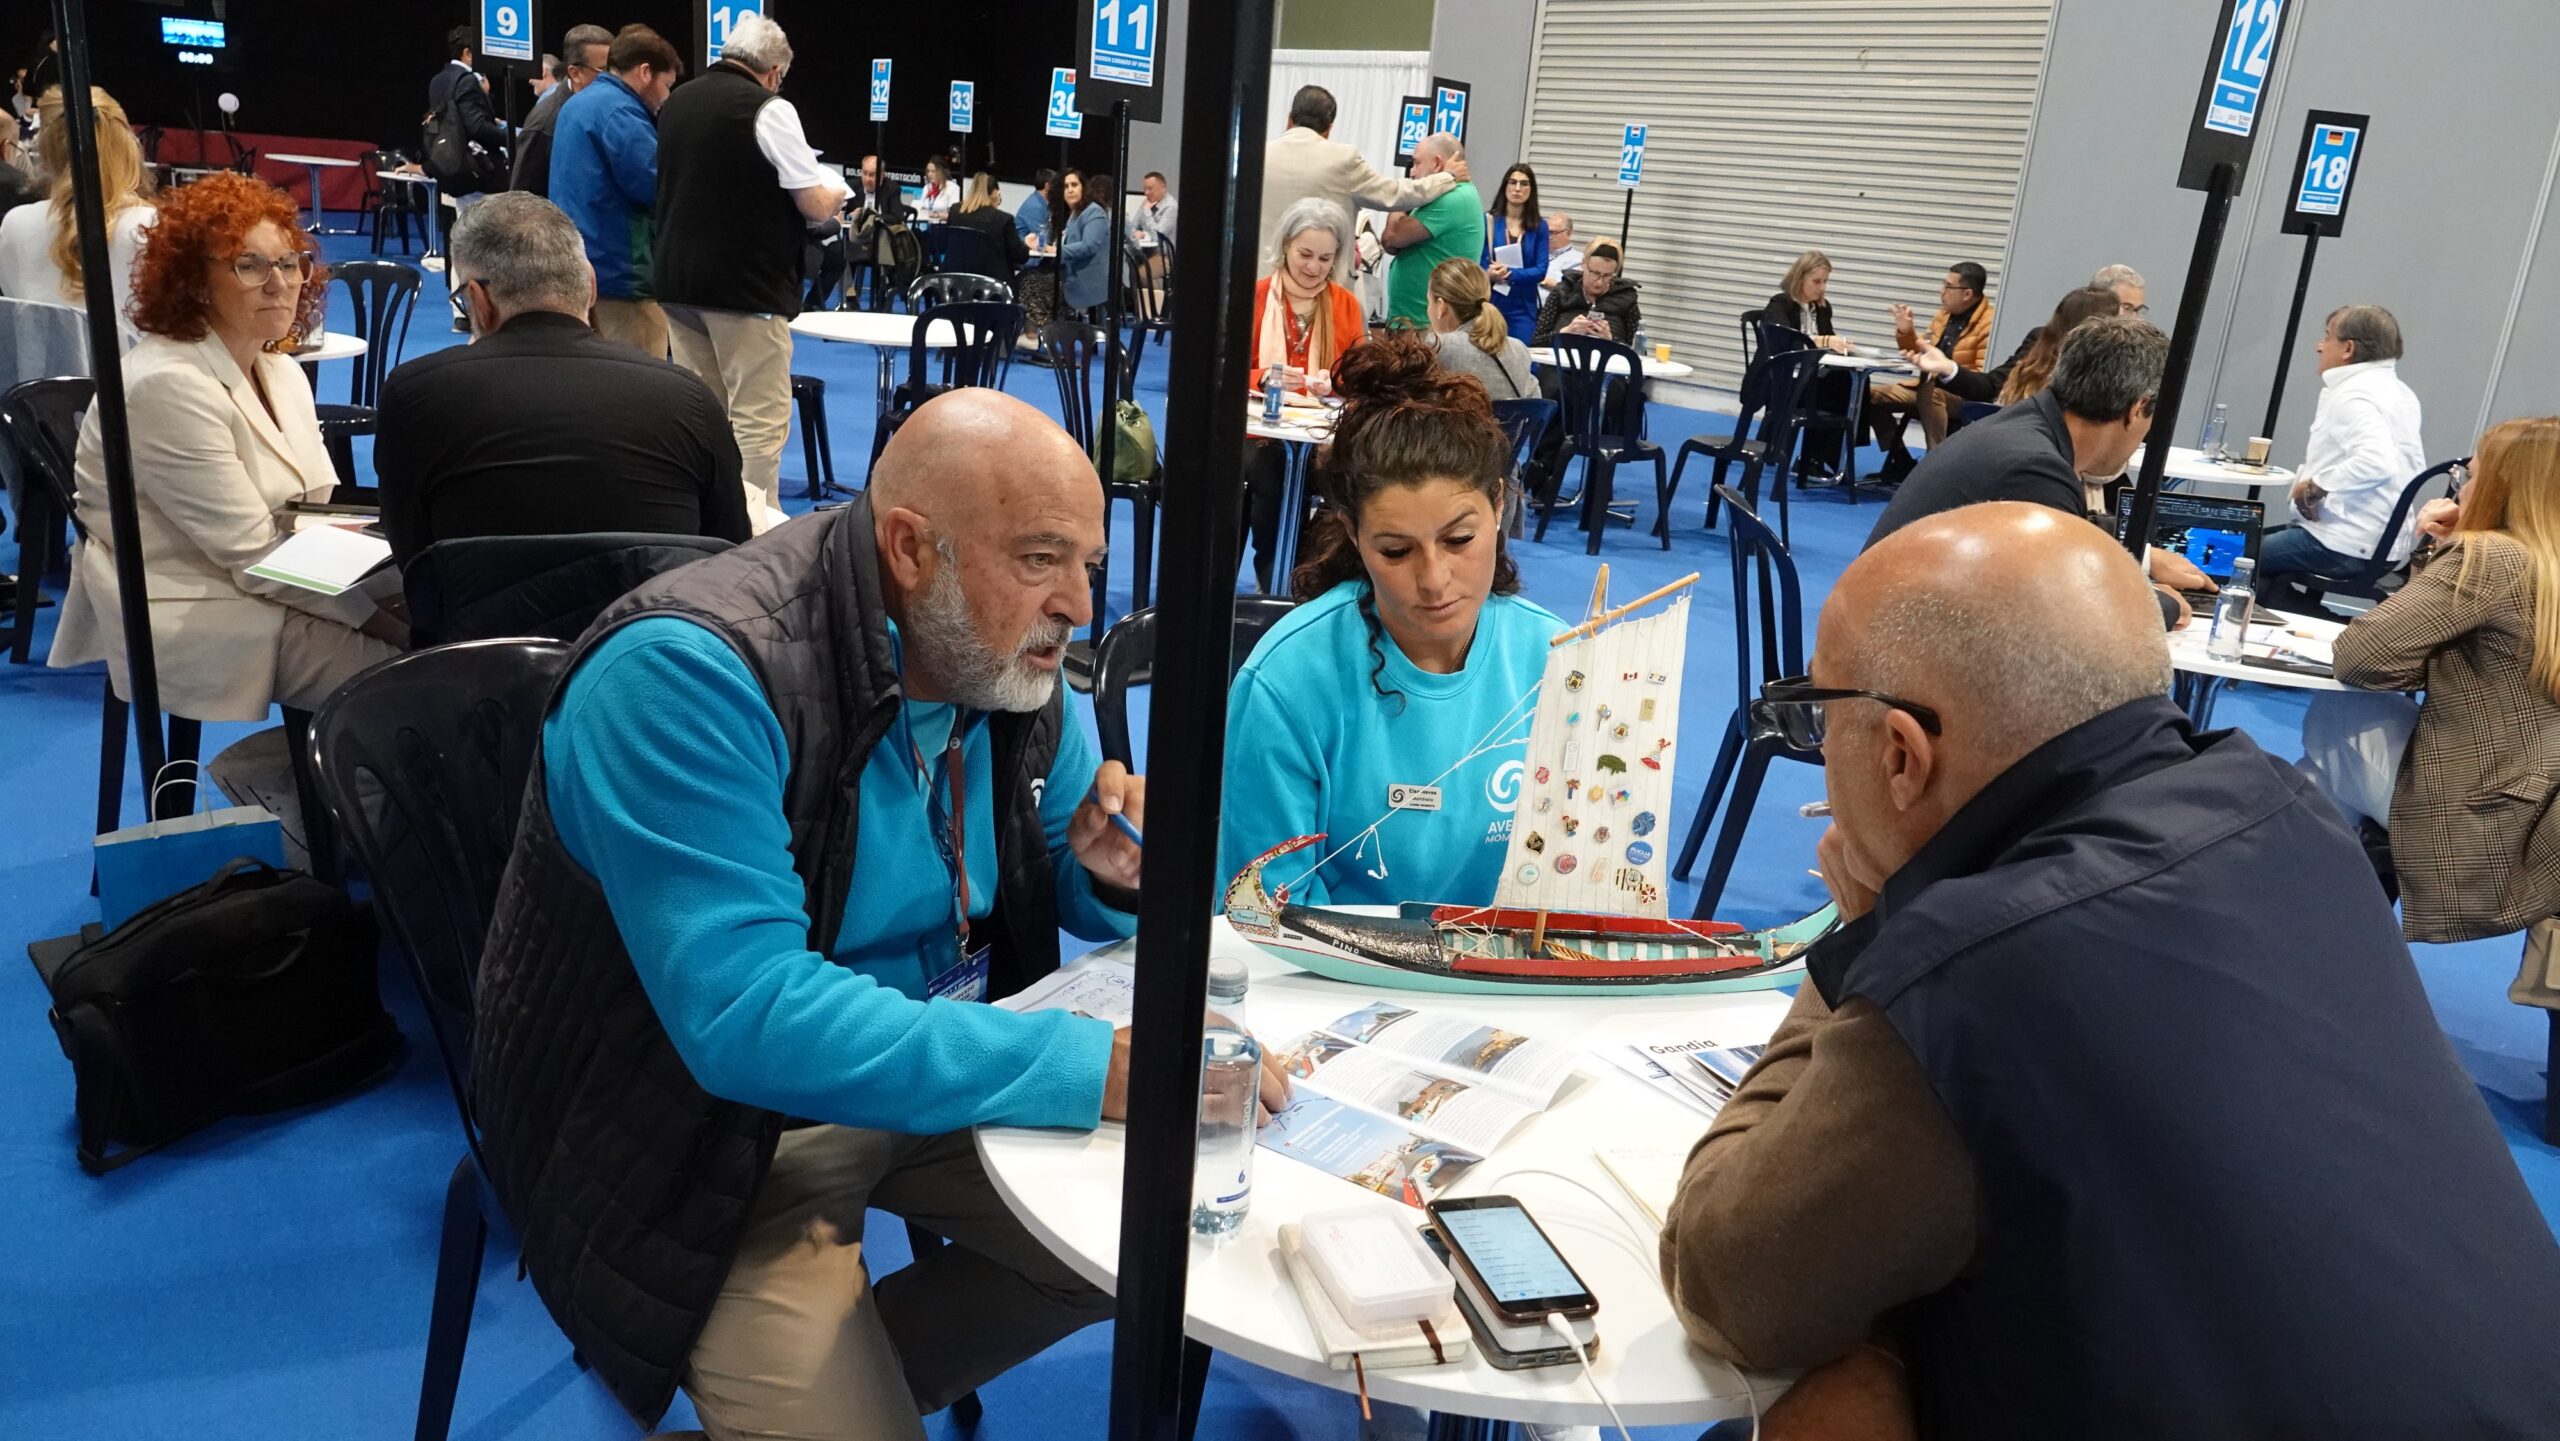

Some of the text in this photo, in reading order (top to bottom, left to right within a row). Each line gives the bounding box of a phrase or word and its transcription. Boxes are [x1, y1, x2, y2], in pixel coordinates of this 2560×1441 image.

[497, 6, 518, 36] 9
[1099, 0, 1148, 50] 11
[2231, 0, 2277, 78] 12
[872, 79, 888, 103] 32
[952, 91, 971, 111] 33
[1404, 121, 1427, 141] 28
[1438, 109, 1462, 133] 17
[1622, 144, 1644, 170] 27
[2310, 154, 2348, 190] 18
[1484, 834, 1511, 844] MOM
[1487, 820, 1513, 834] AVE
[1649, 1040, 1719, 1054] Gandia
